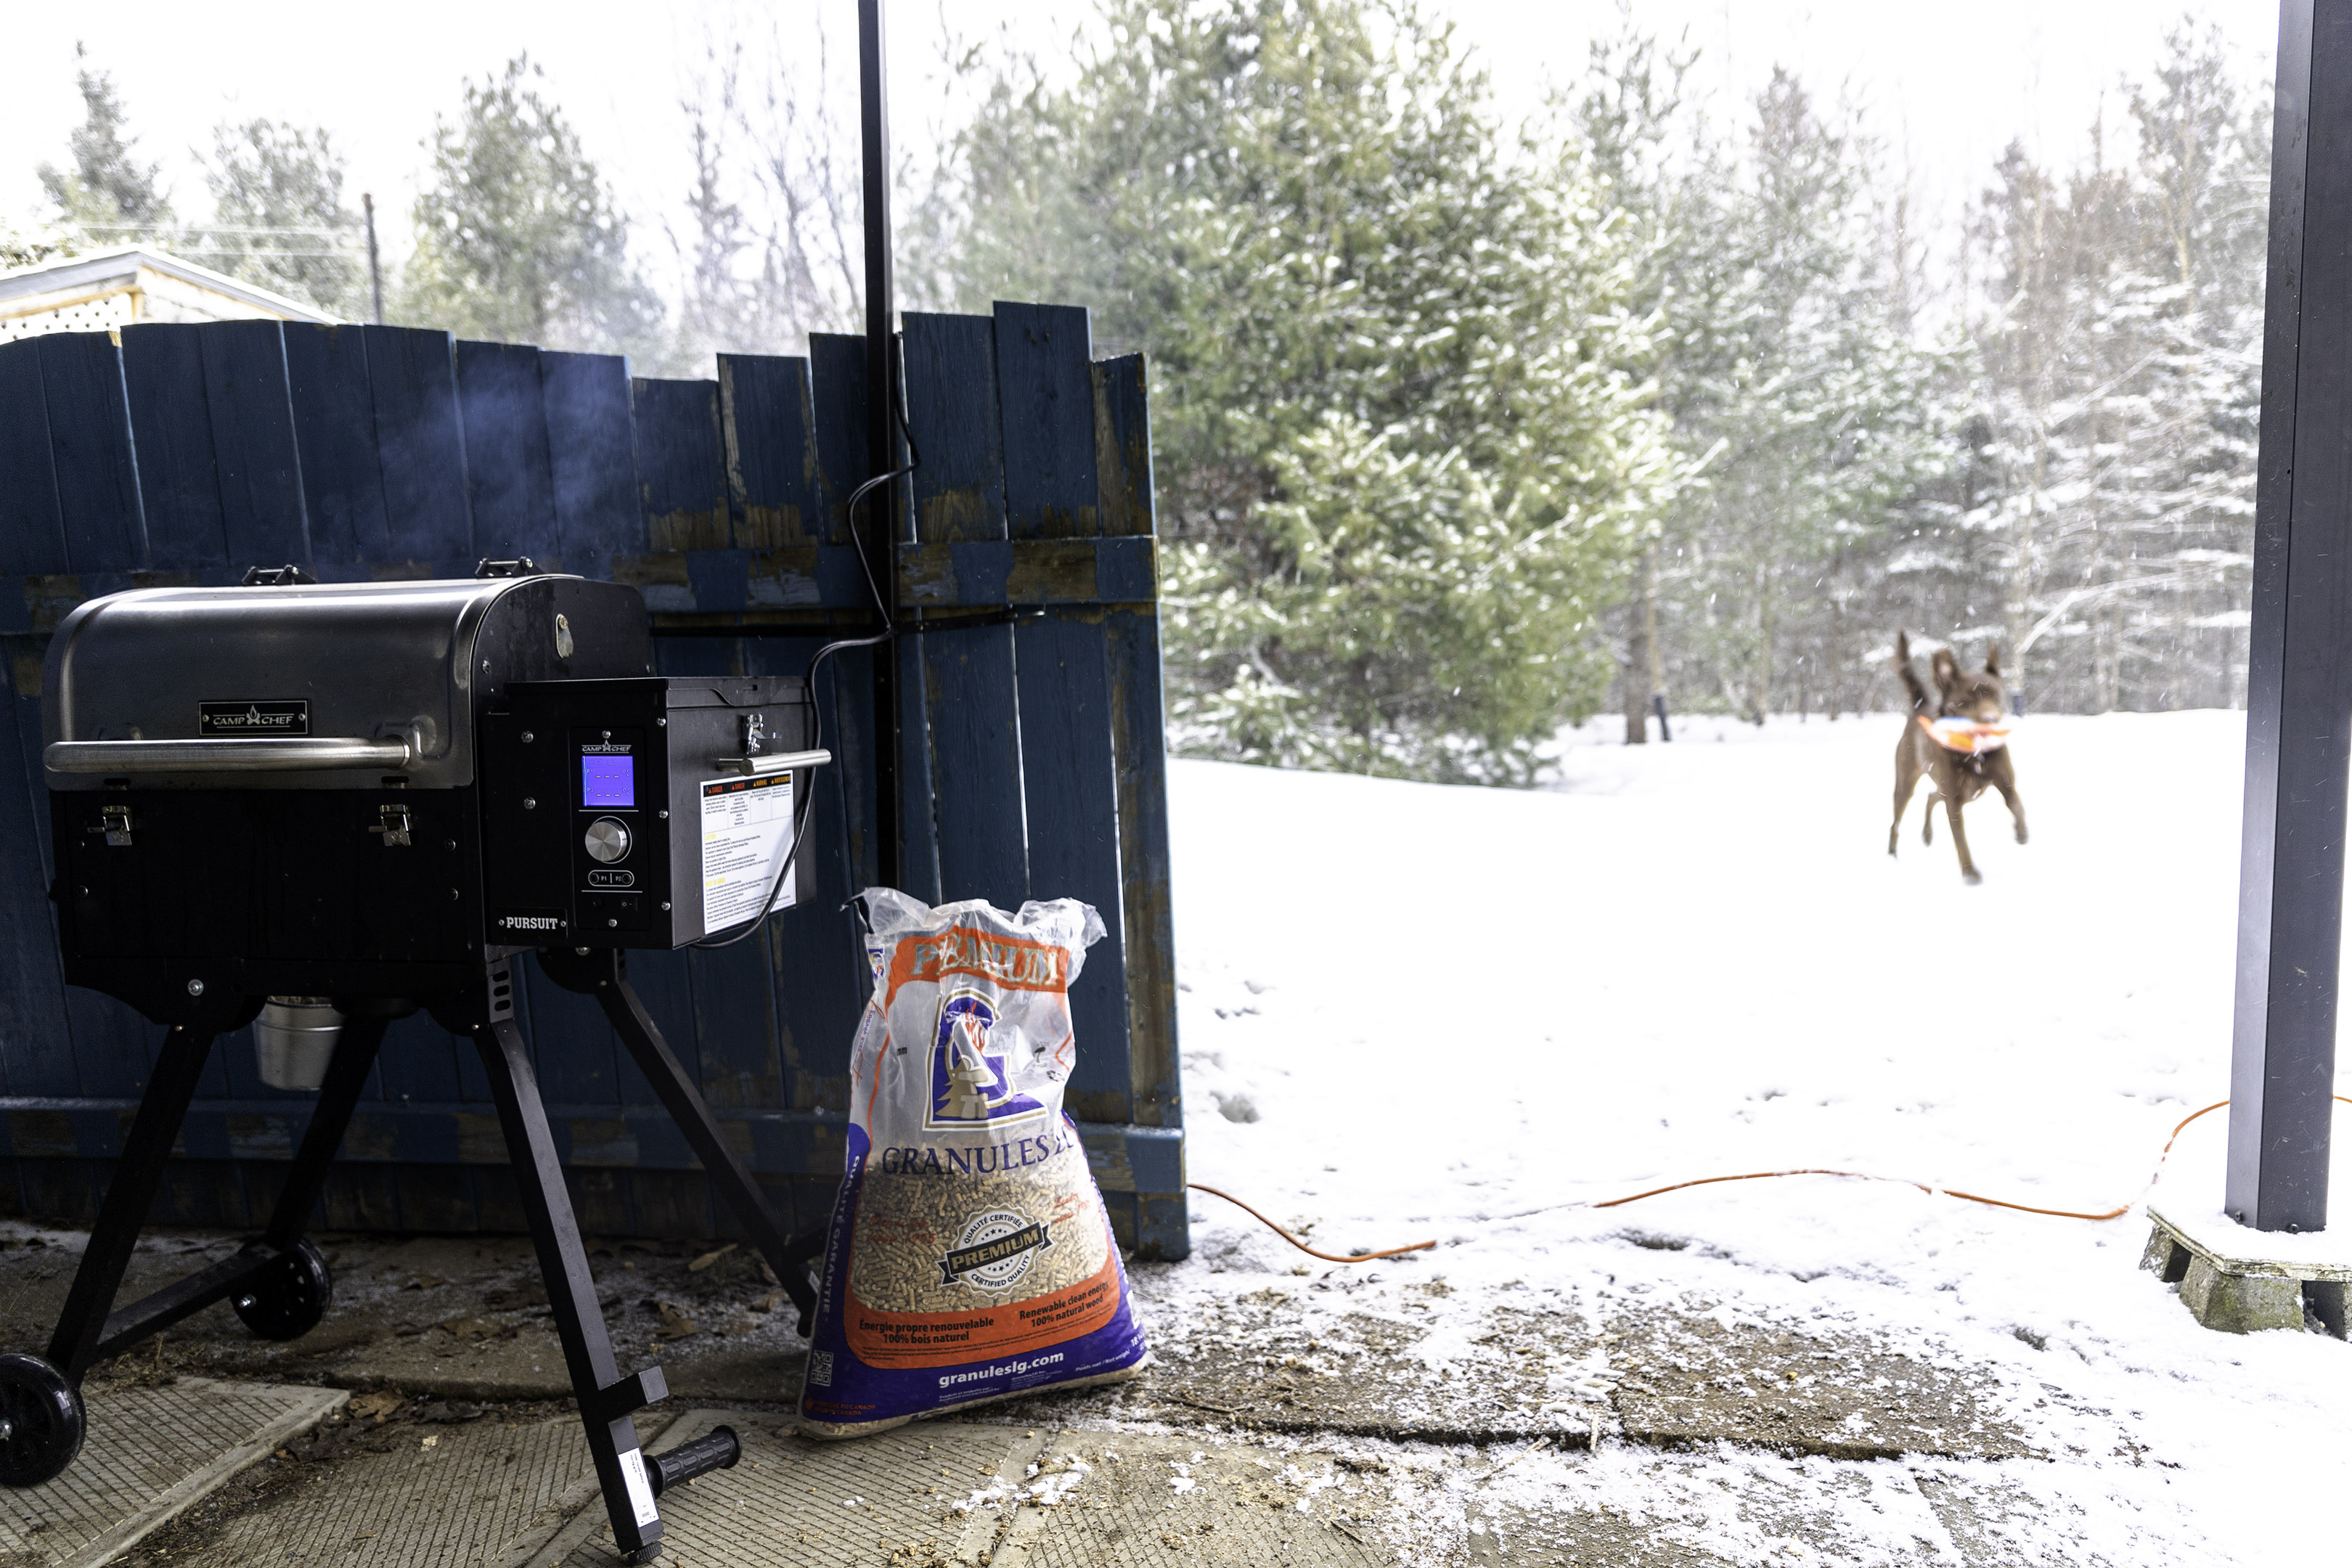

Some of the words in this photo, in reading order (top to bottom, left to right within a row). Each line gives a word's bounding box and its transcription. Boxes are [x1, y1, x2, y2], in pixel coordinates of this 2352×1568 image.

[213, 716, 245, 725] CAMP
[506, 917, 558, 929] PURSUIT
[882, 1135, 1050, 1175] GRANULES
[964, 1217, 989, 1244] QUALITÉ
[990, 1214, 1023, 1228] CERTIFIÉE
[951, 1229, 1040, 1270] PREMIUM
[971, 1273, 1007, 1287] CERTIFIED
[1008, 1254, 1030, 1282] QUALITY
[1019, 1299, 1066, 1320] Renewable
[1068, 1294, 1087, 1305] clean
[1087, 1281, 1109, 1297] energy
[1031, 1314, 1055, 1328] 100%
[1055, 1303, 1085, 1321] natural
[1085, 1294, 1104, 1307] wood
[859, 1318, 894, 1334] Énergie
[896, 1323, 928, 1334] propre
[930, 1317, 995, 1332] renouvelable
[883, 1334, 908, 1344] 100%
[910, 1334, 931, 1344] bois
[933, 1331, 970, 1343] naturel
[939, 1352, 1064, 1388] granuleslg.com
